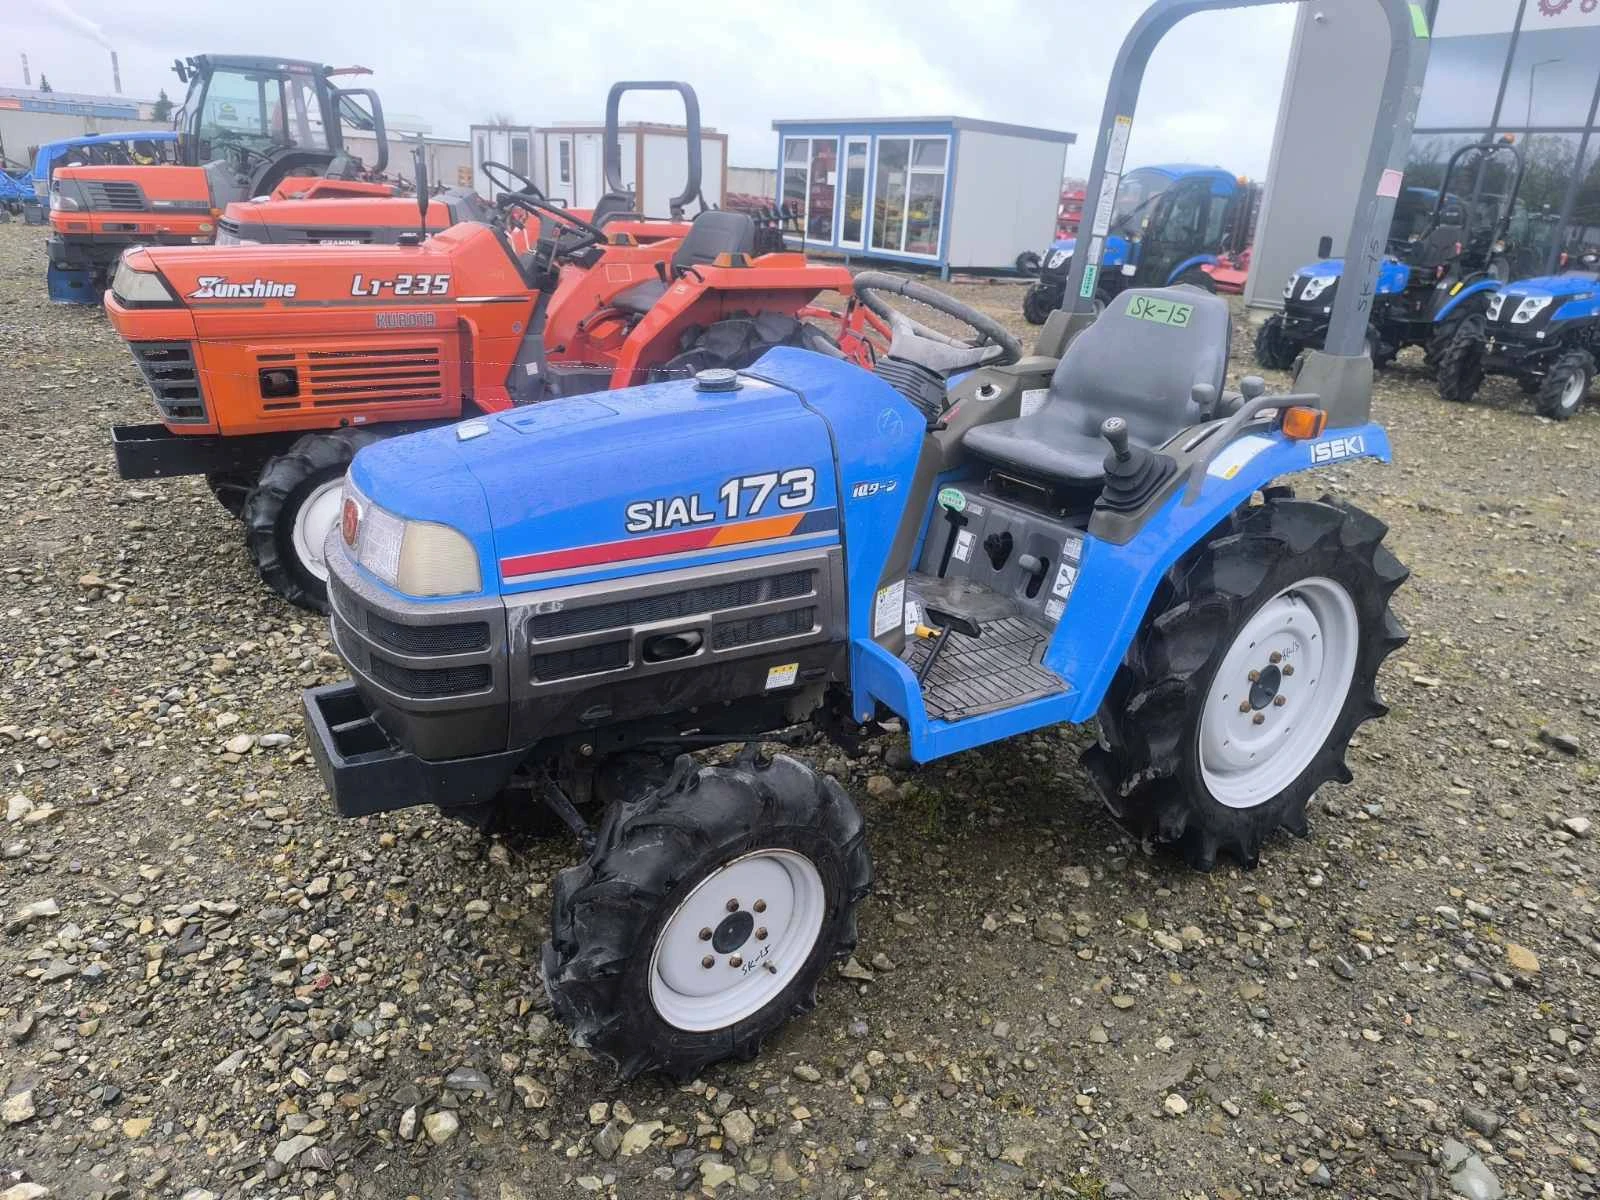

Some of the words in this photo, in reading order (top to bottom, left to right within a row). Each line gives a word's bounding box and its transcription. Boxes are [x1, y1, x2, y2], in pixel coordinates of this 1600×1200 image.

[185, 276, 297, 299] Sunshine
[1131, 297, 1190, 324] SK-15
[1310, 435, 1364, 464] ISEKI
[625, 493, 716, 534] SIAL
[719, 466, 817, 519] 173
